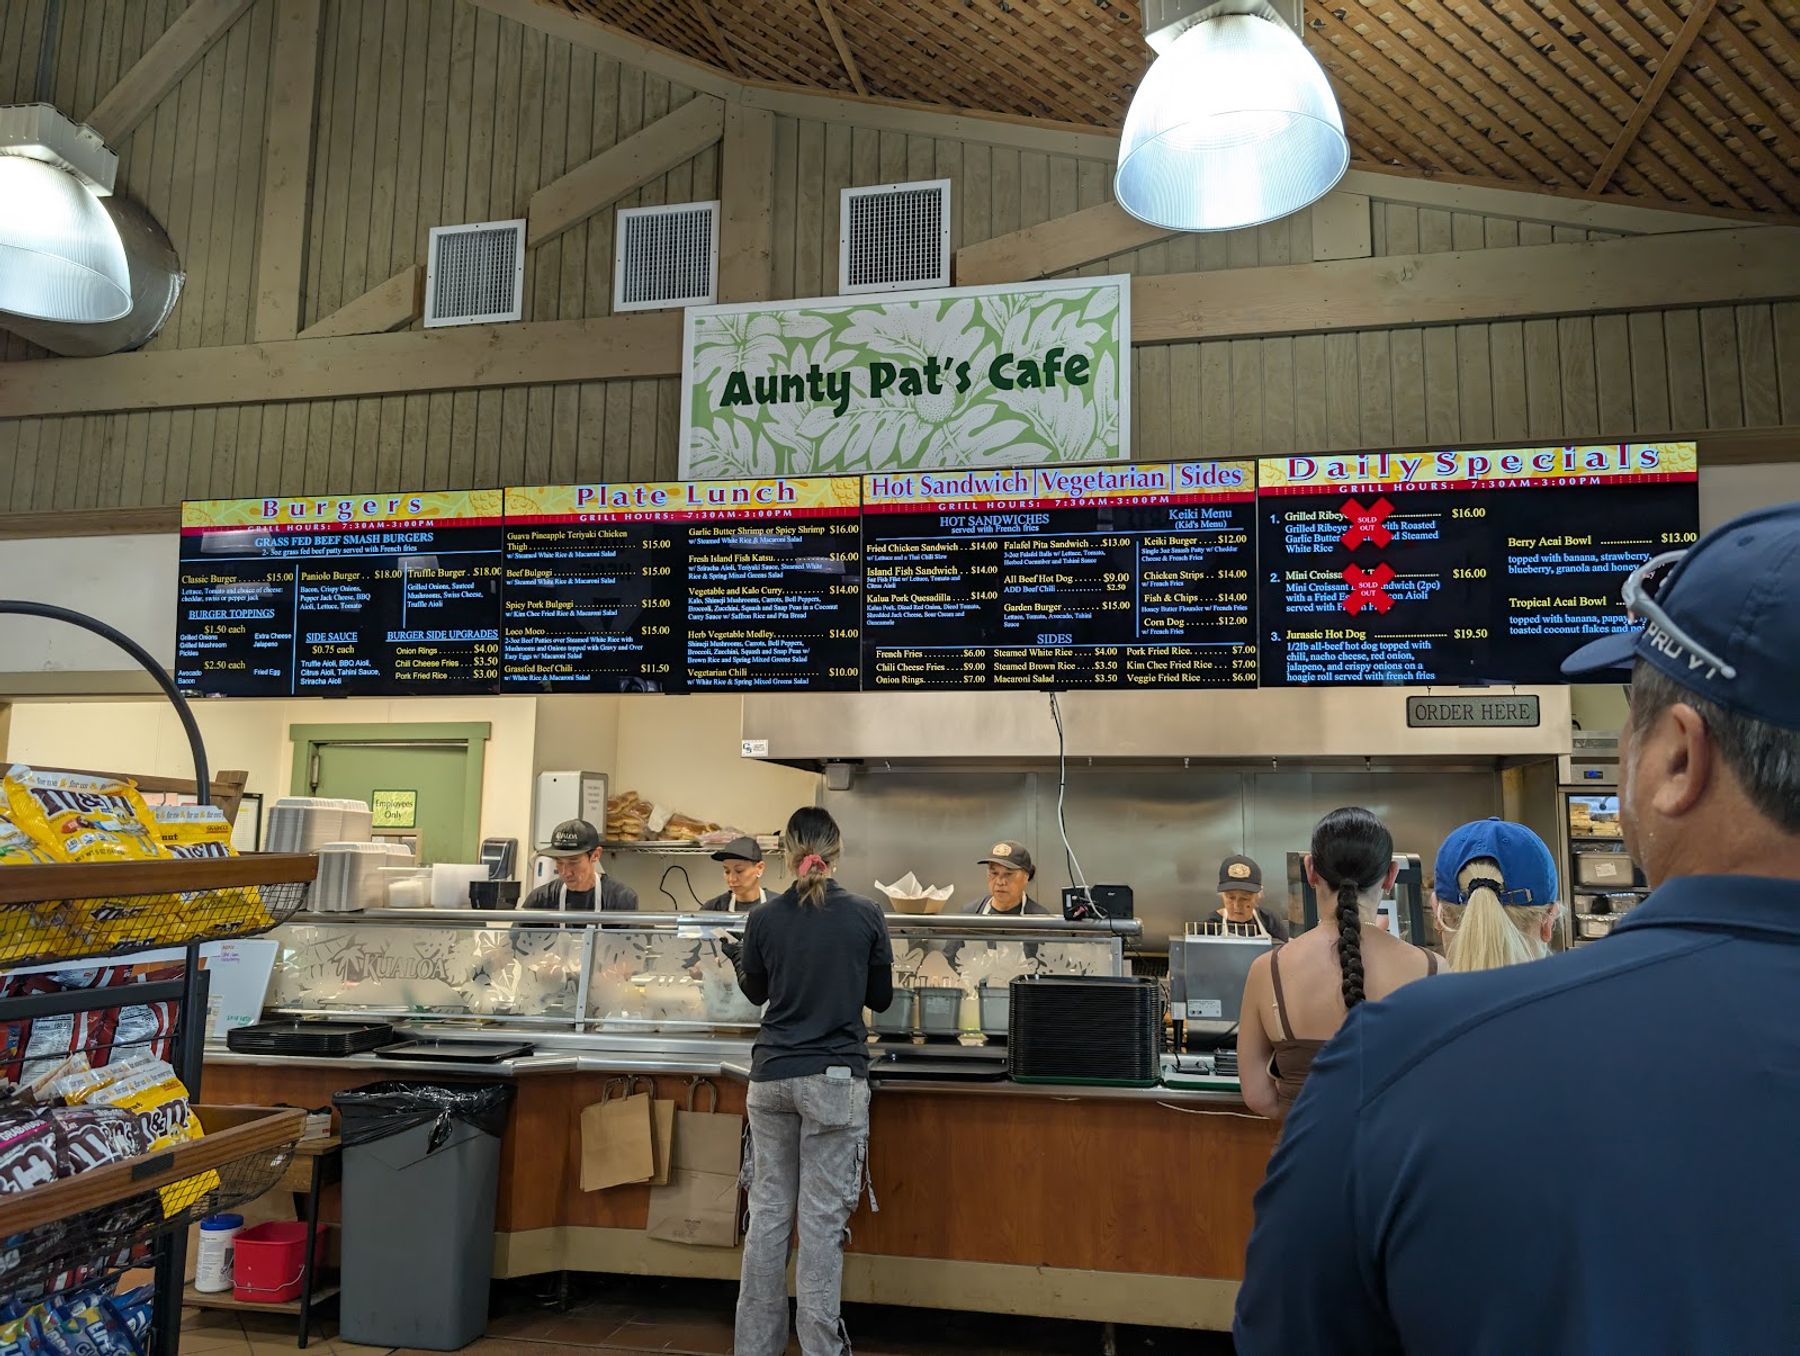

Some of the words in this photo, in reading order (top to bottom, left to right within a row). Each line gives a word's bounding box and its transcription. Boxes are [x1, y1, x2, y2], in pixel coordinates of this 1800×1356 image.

[720, 364, 851, 418] Aunty
[870, 357, 972, 398] Pat's
[988, 348, 1090, 389] Cafe
[1287, 453, 1422, 482] Daily
[1435, 443, 1660, 480] Specials
[872, 477, 913, 497] Hot
[920, 472, 1029, 495] Sandwich
[1041, 466, 1166, 497] Vegetarian
[1180, 463, 1243, 487] Sides
[1339, 483, 1384, 494] GRILL
[1394, 482, 1454, 491] HOURS:
[576, 485, 668, 508] Plate
[686, 480, 797, 506] Lunch
[262, 498, 423, 522] Burgers
[939, 502, 978, 510] GRILL
[987, 501, 1040, 509] HOURS:
[1169, 509, 1198, 519] Keiki
[1201, 509, 1232, 518] Menu
[1270, 515, 1280, 524] 1.
[1285, 512, 1316, 520] Grilled
[1452, 508, 1486, 518] $16.00
[940, 516, 965, 527] HOT
[968, 514, 1049, 526] SANDWICHES
[1175, 521, 1198, 530] (Kid's
[1201, 520, 1226, 529] Menu)
[1401, 521, 1435, 530] Roasted
[995, 525, 1020, 533] French
[1285, 524, 1316, 533] Grilled
[1318, 524, 1347, 533] Ribeye
[255, 537, 289, 547] GRASS
[291, 536, 312, 546] FED
[314, 535, 340, 545] BEEF
[342, 534, 380, 544] SMASH
[383, 532, 433, 543] BURGERS
[1285, 534, 1313, 543] Garlic
[1315, 534, 1340, 543] Butter
[1401, 531, 1439, 540] Steamed
[1508, 537, 1535, 549] Berry
[1539, 536, 1562, 546] Acai
[1565, 535, 1591, 545] Bowl
[1661, 532, 1696, 543] $13.00
[1286, 545, 1313, 553] White
[752, 554, 774, 562] Katsu
[830, 553, 858, 561] $16.00
[1508, 554, 1539, 564] topped
[1542, 554, 1561, 563] with
[1564, 553, 1598, 563] banana,
[1601, 552, 1652, 562] strawberry,
[867, 568, 892, 576] Island
[895, 567, 913, 575] Fish
[916, 567, 958, 575] Sandwich
[971, 566, 998, 574] $14.00
[1508, 565, 1553, 574] blueberry,
[1556, 564, 1590, 574] granola
[301, 572, 330, 582] Paniolo
[333, 571, 360, 582] Burger
[374, 569, 402, 580] $18.00
[1144, 571, 1177, 580] Chicken
[1180, 571, 1204, 581] Strips
[1218, 570, 1247, 579] $14.00
[1271, 574, 1280, 582] 2.
[1286, 571, 1307, 580] Mini
[1453, 569, 1486, 579] $16.00
[1286, 583, 1308, 591] Mini
[1310, 583, 1349, 591] Croissant
[1417, 581, 1440, 591] (2pc)
[1144, 594, 1162, 602] Fish
[1174, 593, 1198, 603] Chips
[1218, 593, 1247, 602] $14.00
[1509, 597, 1550, 609] Tropical
[1554, 597, 1577, 606] Acai
[1580, 596, 1607, 606] Bowl
[506, 601, 526, 609] Spicy
[546, 600, 574, 609] Bulgogi
[642, 599, 670, 608] $15.00
[1509, 615, 1540, 625] topped
[1543, 614, 1562, 623] with
[1564, 614, 1599, 624] banana,
[1602, 616, 1632, 624] papay
[1510, 626, 1541, 634] toasted
[1544, 626, 1580, 634] coconut
[1582, 625, 1609, 633] flakes
[306, 632, 326, 642] SIDE
[329, 632, 357, 642] SAUCE
[1271, 632, 1280, 641] 3.
[1286, 630, 1322, 640] Jurassic
[1324, 630, 1343, 639] Hot
[1345, 630, 1366, 640] Dog
[1454, 629, 1488, 638] $19.50
[312, 645, 334, 655] $0.75
[336, 645, 355, 654] each
[1287, 642, 1308, 651] 1/2lb
[1310, 642, 1343, 650] all-beef
[1345, 642, 1360, 650] hot
[1362, 642, 1378, 651] dog
[1380, 642, 1410, 651] topped
[1287, 652, 1308, 662] chili,
[1338, 652, 1368, 661] cheese,
[1387, 652, 1414, 661] onion,
[1327, 662, 1343, 670] and
[1345, 662, 1371, 672] crispy
[688, 669, 727, 678] Vegetarian
[728, 668, 747, 676] Chili
[829, 668, 858, 677] $10.00
[1287, 673, 1316, 683] hoagie
[1318, 672, 1332, 680] roll
[1335, 672, 1362, 680] served
[1364, 672, 1384, 680] with
[1386, 672, 1413, 680] french
[1416, 671, 1435, 679] fries
[1415, 704, 1474, 721] ORDER
[1482, 703, 1530, 720] HERE
[376, 799, 413, 810] Employees
[384, 810, 402, 820] Only
[361, 952, 447, 981] KUALOA
